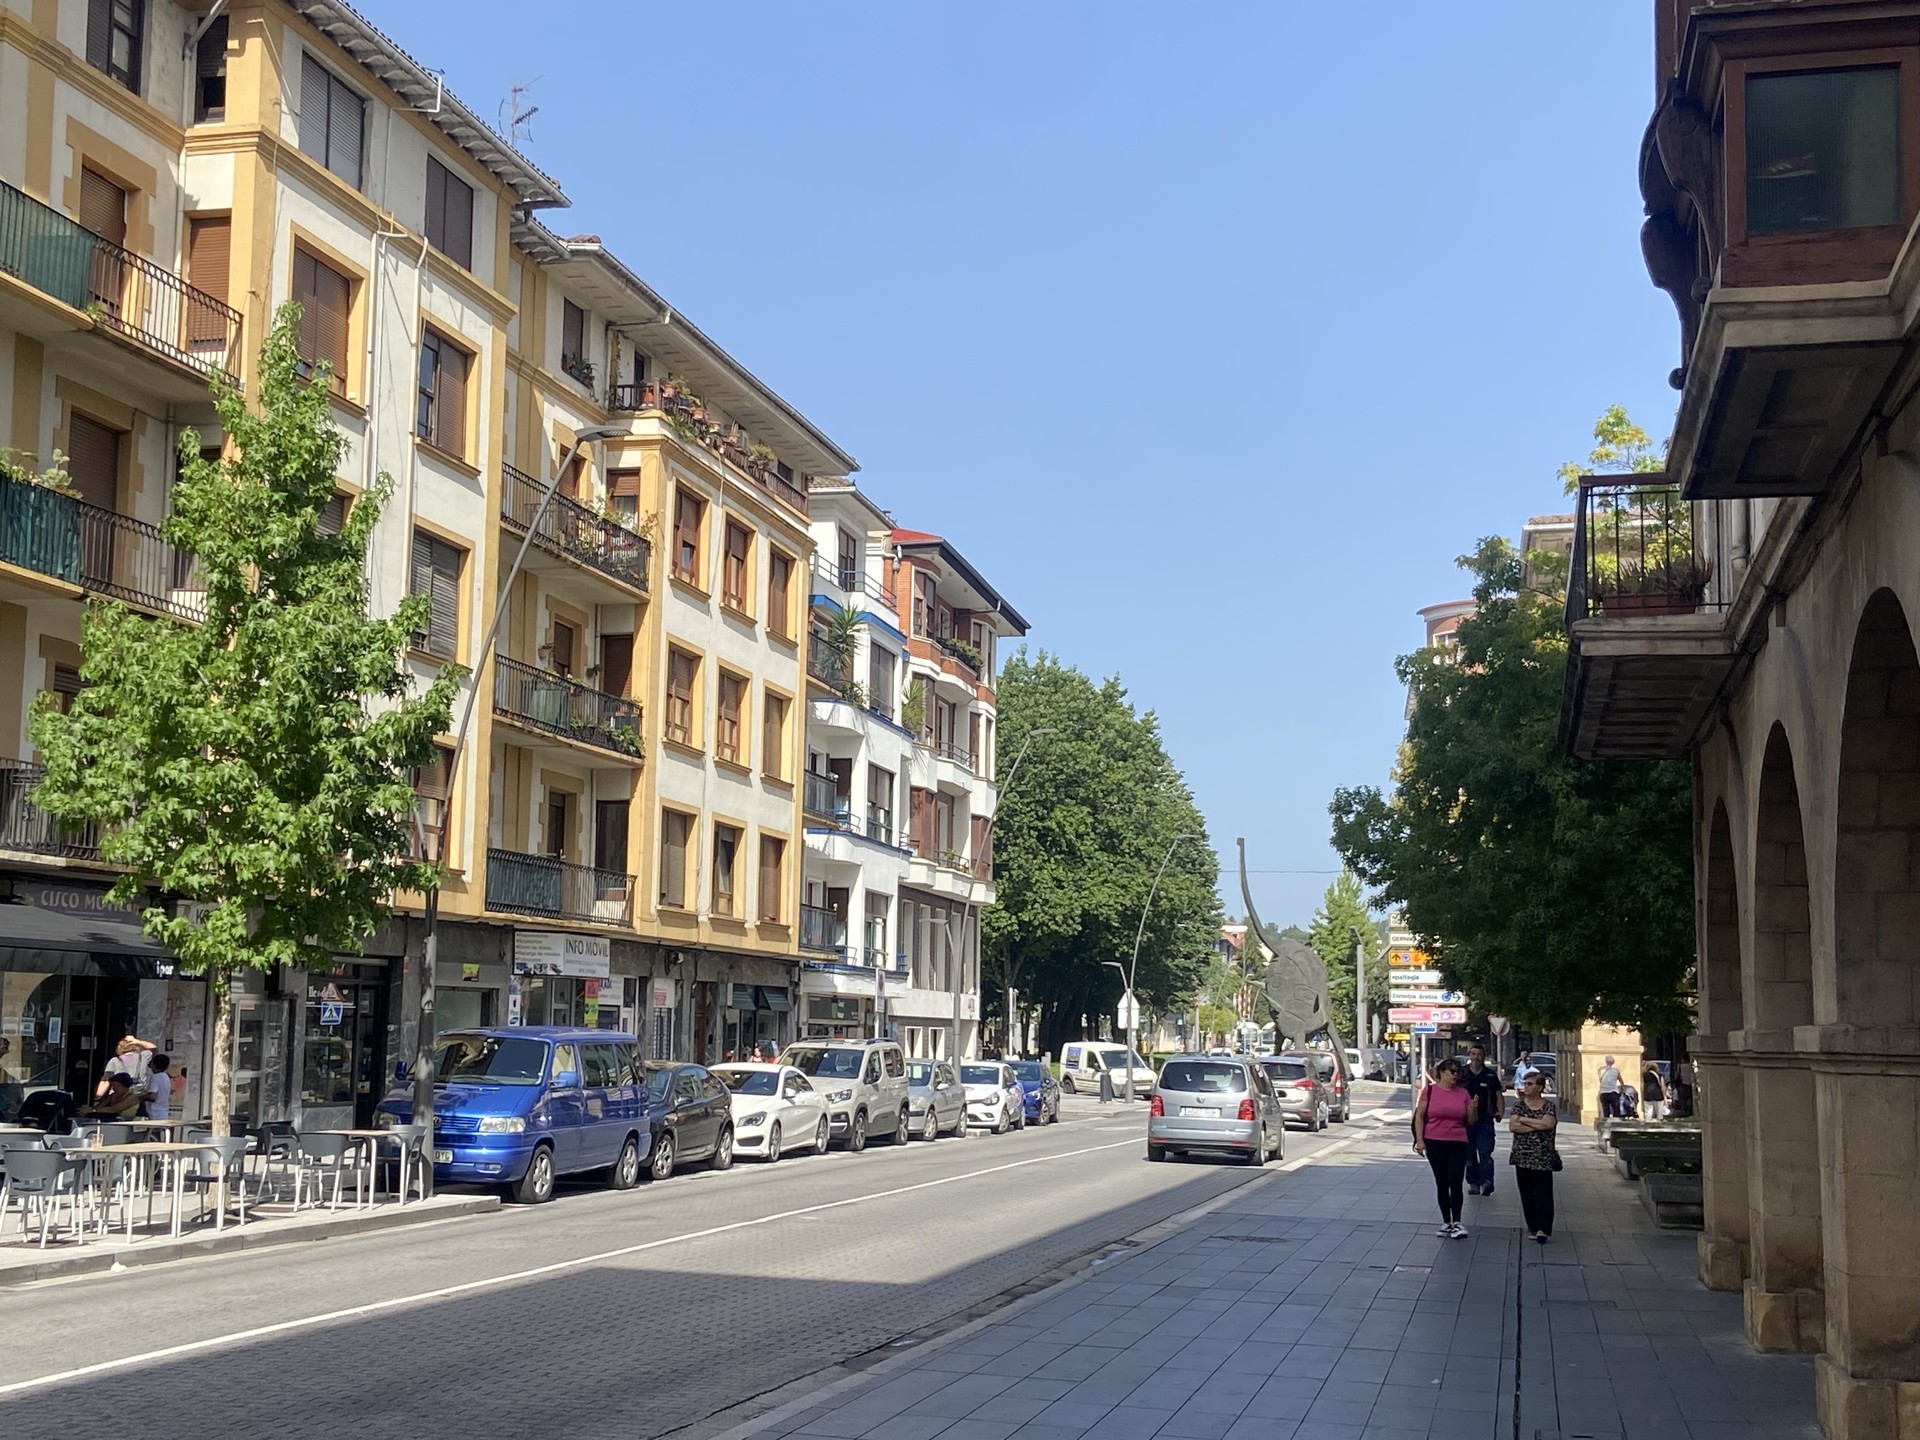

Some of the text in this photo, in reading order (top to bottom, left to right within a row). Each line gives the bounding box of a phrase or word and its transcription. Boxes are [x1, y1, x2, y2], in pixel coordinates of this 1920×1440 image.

[41, 890, 80, 909] CISCO
[565, 938, 608, 957] INFO MÓVIL
